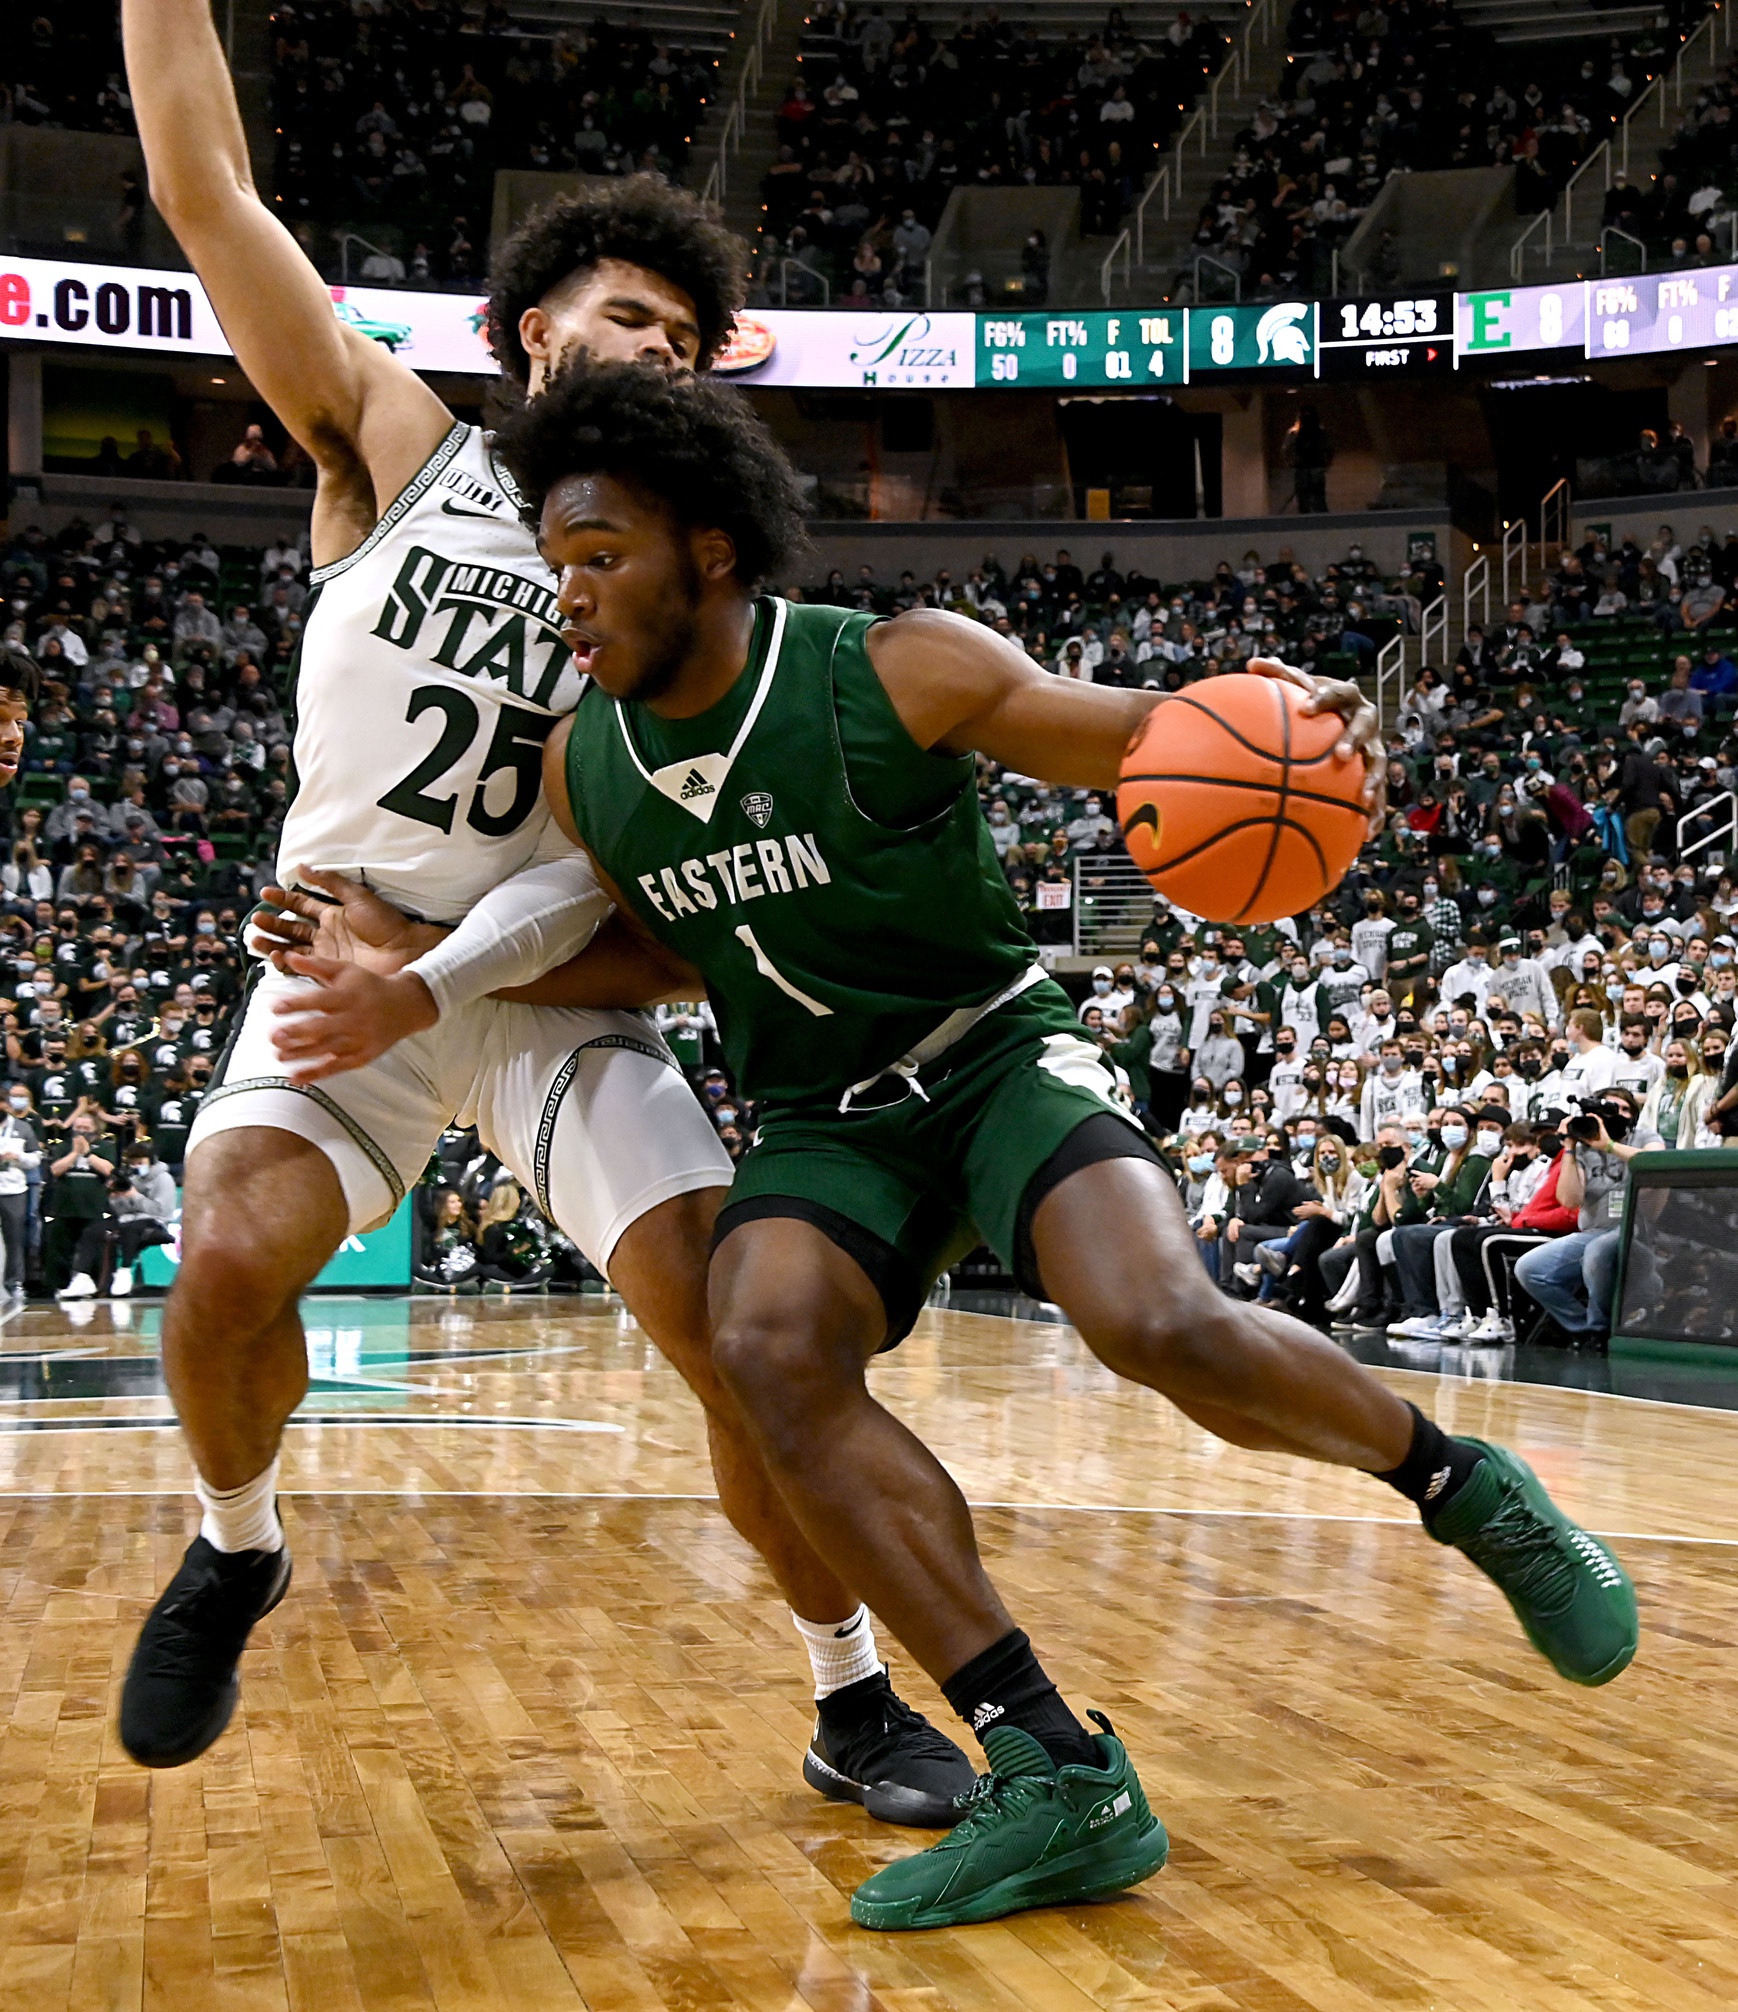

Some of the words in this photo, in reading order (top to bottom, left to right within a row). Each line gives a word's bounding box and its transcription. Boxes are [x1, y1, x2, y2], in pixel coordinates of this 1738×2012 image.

[1596, 285, 1638, 316] FG%
[1658, 279, 1699, 309] FT%
[1717, 274, 1731, 302] F
[984, 321, 1026, 347] FG%
[1046, 320, 1087, 346] FT%
[1107, 319, 1120, 345] F
[1138, 318, 1174, 344] TOL
[1210, 315, 1234, 365] 8
[1340, 299, 1437, 338] 14:53
[1467, 291, 1511, 350] E
[991, 353, 1018, 381] 50
[1062, 352, 1077, 379] 0
[1148, 350, 1164, 377] 4
[1365, 349, 1410, 367] FIRST
[440, 468, 503, 512] UNITY
[451, 565, 572, 630] MICHIG
[376, 685, 562, 837] 25
[680, 784, 715, 800] adidas
[637, 833, 832, 922] EASTERN
[735, 924, 834, 1016] 1
